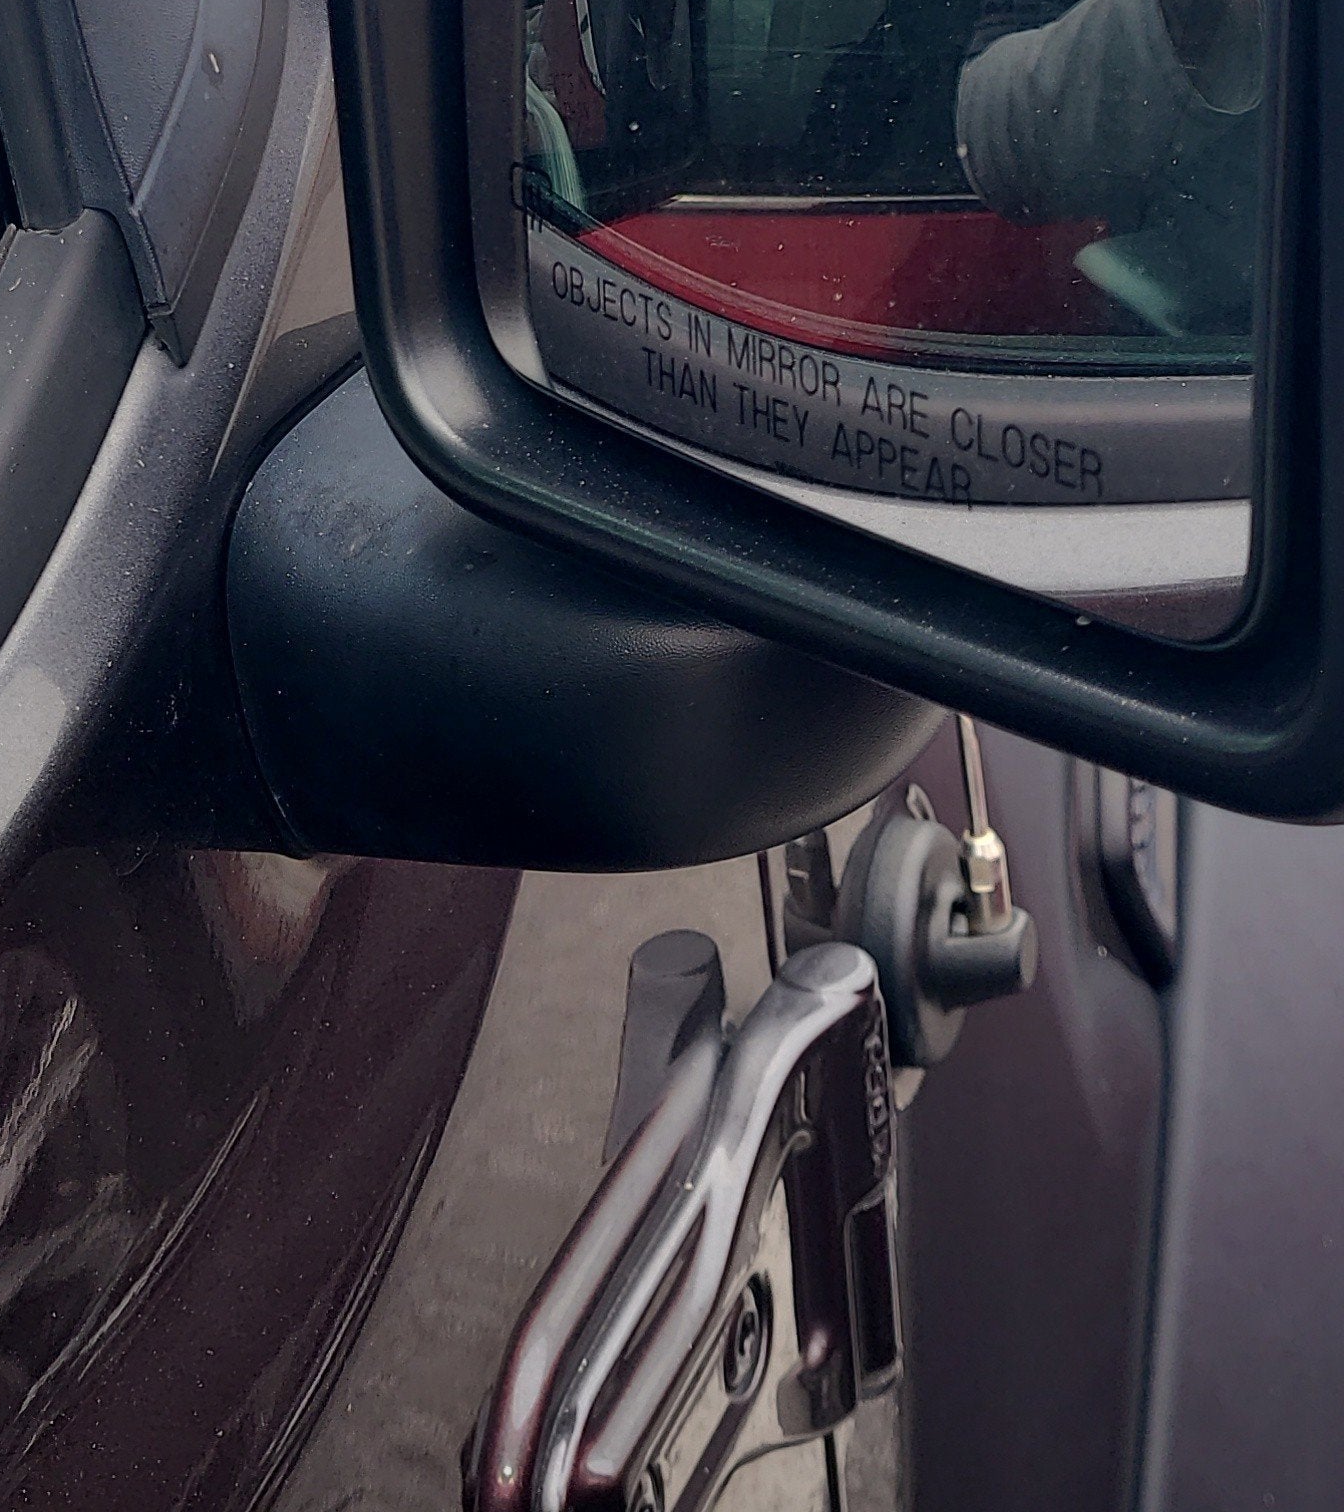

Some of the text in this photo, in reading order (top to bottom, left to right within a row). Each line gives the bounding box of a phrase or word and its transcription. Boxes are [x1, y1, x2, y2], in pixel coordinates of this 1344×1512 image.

[552, 261, 1102, 496] OBJECTS IN MIRROR ARE CLOSER
[642, 346, 973, 510] THAN THEY APPEAR
